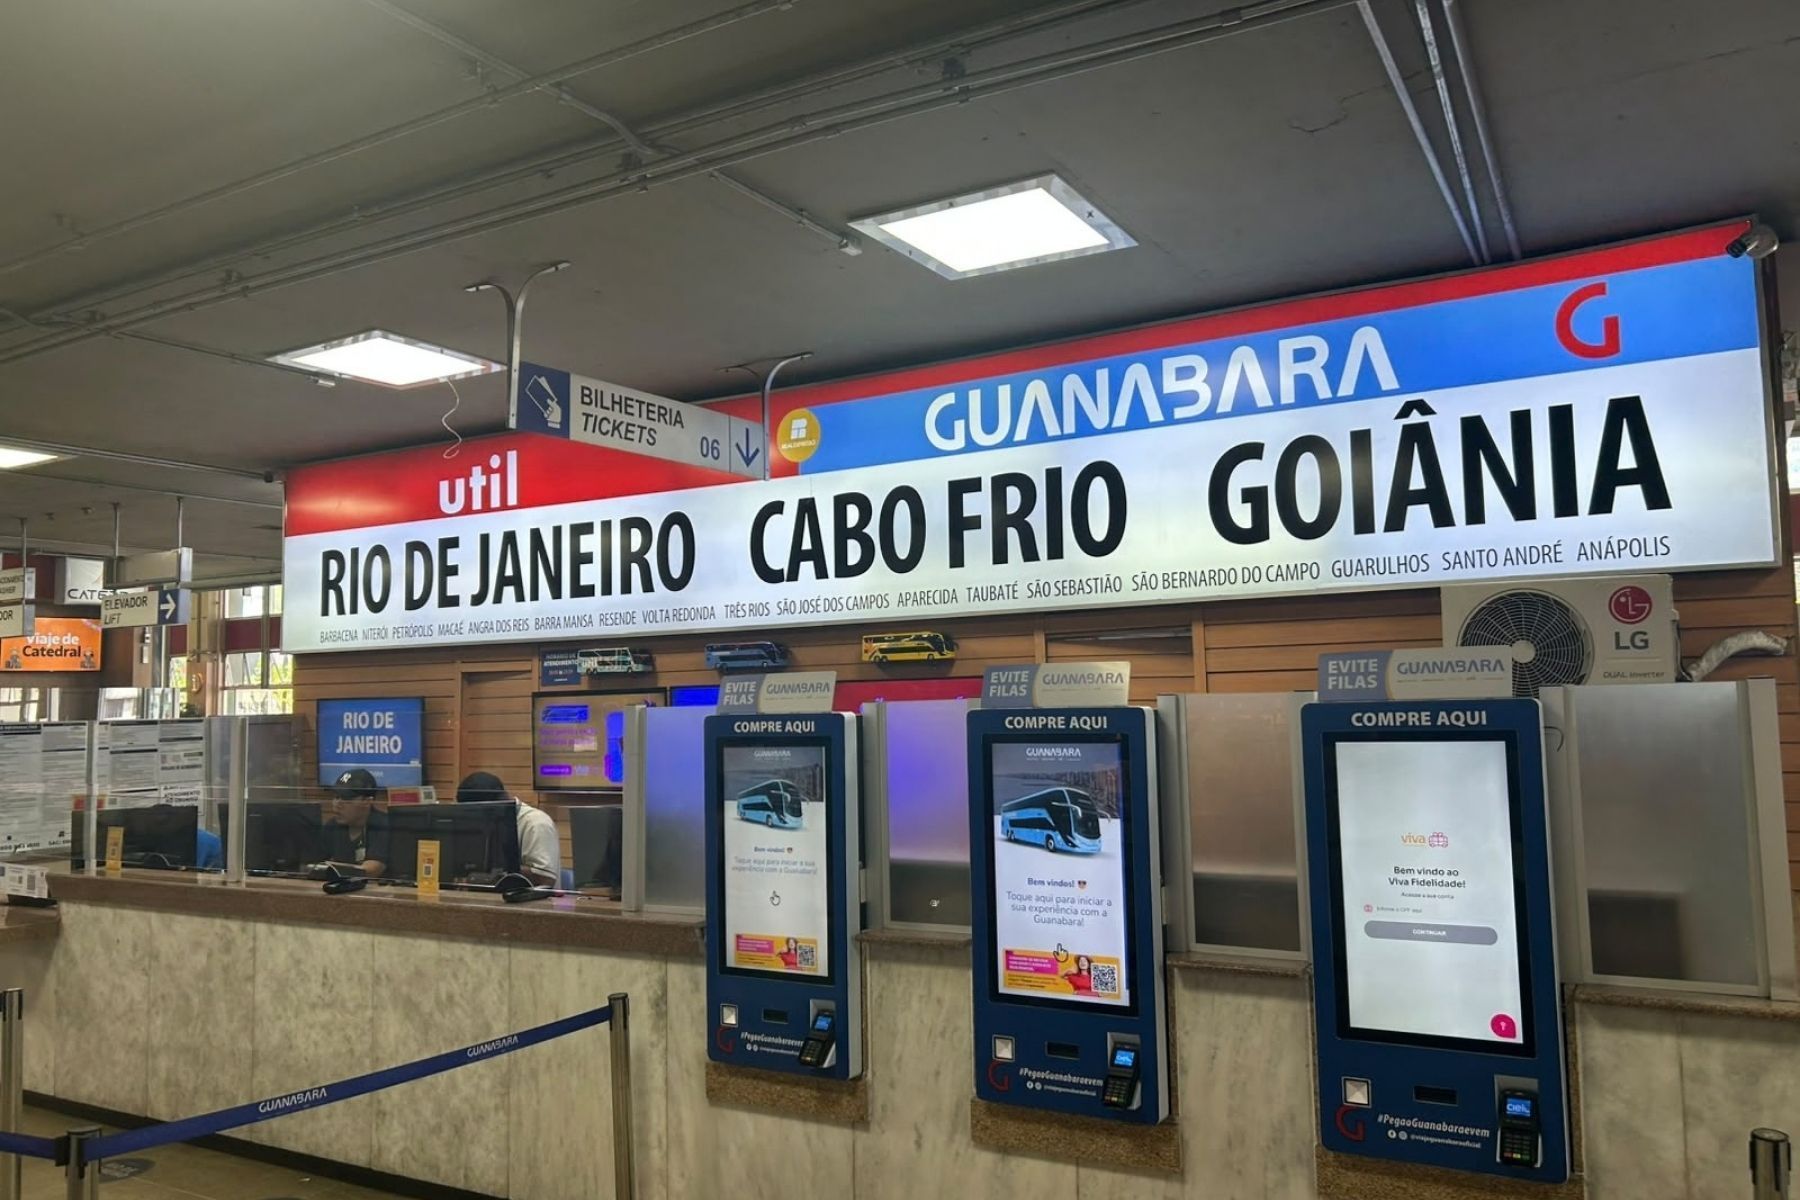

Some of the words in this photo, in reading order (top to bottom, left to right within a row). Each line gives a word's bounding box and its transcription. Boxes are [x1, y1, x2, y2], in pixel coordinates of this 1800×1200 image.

[925, 326, 1400, 452] GUANABARA
[580, 385, 684, 429] BILHETERIA
[581, 412, 657, 446] TICKETS
[700, 436, 720, 460] 06
[1208, 395, 1673, 546] GOIÂNIA
[439, 450, 518, 514] util
[750, 485, 927, 584] CABO
[948, 461, 1127, 569] FRIO
[320, 544, 391, 617] RIO
[405, 536, 460, 612] DE
[470, 511, 696, 607] JANEIRO
[320, 629, 358, 643] BARBACENA
[362, 625, 388, 640] NITERÓI
[392, 623, 433, 639] PETRÓPOLIS
[438, 620, 463, 636] MACAÉ
[468, 620, 494, 634] ANGRA
[496, 619, 511, 632] DOS
[513, 618, 529, 631] REIS
[534, 616, 561, 631] BARRA
[563, 614, 593, 629] MANSA
[600, 610, 636, 627] RESENDE
[642, 608, 671, 624] VOLTA
[673, 606, 716, 622] REDONDA
[724, 602, 747, 618] TRÊS
[749, 601, 770, 617] RIOS
[776, 598, 796, 615] SÃO
[798, 595, 821, 615] JOSÉ
[823, 596, 843, 613] DOS
[845, 593, 890, 611] CAMPOS
[897, 588, 958, 607] APARECIDA
[966, 580, 1018, 603] TAUBATÉ
[1027, 578, 1050, 599] SÃO
[1054, 573, 1122, 597] SEBASTIÃO
[1132, 571, 1158, 592] SÃO
[1162, 567, 1238, 590] BERNARDO
[1241, 564, 1261, 584] DO
[1265, 562, 1321, 582] CAMPO
[1331, 553, 1430, 578] GUARULHOS
[1442, 547, 1498, 572] SANTO
[1503, 539, 1563, 568] ANDRÉ
[1576, 535, 1670, 562] ANÁPOLIS
[104, 596, 148, 610] ELEVADOR
[104, 613, 121, 625] LIFT
[62, 633, 79, 645] de
[1614, 631, 1649, 650] LG
[22, 645, 81, 658] Catedral
[1328, 658, 1378, 674] EVITE
[1397, 659, 1505, 675] GUANABARA
[990, 671, 1029, 684] EVITE
[1043, 673, 1124, 685] GUANABARA
[1328, 675, 1377, 689] FILAS
[725, 681, 757, 694] EVITE
[766, 682, 830, 694] GUANABARA
[989, 684, 1027, 697] FILAS
[723, 694, 755, 706] FILAS
[343, 712, 369, 729] RIO
[373, 711, 394, 729] DE
[1005, 716, 1065, 729] COMPRE
[1069, 716, 1108, 730] AQUI
[1351, 711, 1431, 726] COMPRE
[1437, 710, 1487, 727] AQUI
[734, 721, 782, 733] COMPRE
[785, 720, 815, 733] AQUI
[336, 735, 402, 754] JANEIRO
[1026, 747, 1081, 758] GUANABARA
[1401, 832, 1426, 844] viva
[1393, 866, 1415, 875] Bem
[1417, 867, 1445, 876] vindo
[1447, 869, 1459, 877] ao
[1027, 877, 1046, 887] Bem
[1388, 877, 1409, 886] Viva
[1411, 878, 1466, 888] Fidelidade!
[1006, 891, 1033, 903] Toque
[1034, 893, 1053, 905] aqui
[1055, 896, 1076, 906] para
[1011, 904, 1026, 912] sua
[1028, 903, 1078, 916] experiência
[1080, 907, 1099, 916] com
[466, 1035, 519, 1058] GUANABARA
[258, 1087, 327, 1114] GUANABARA
[1377, 1113, 1490, 1138] #PegaoGuanabaraevem
